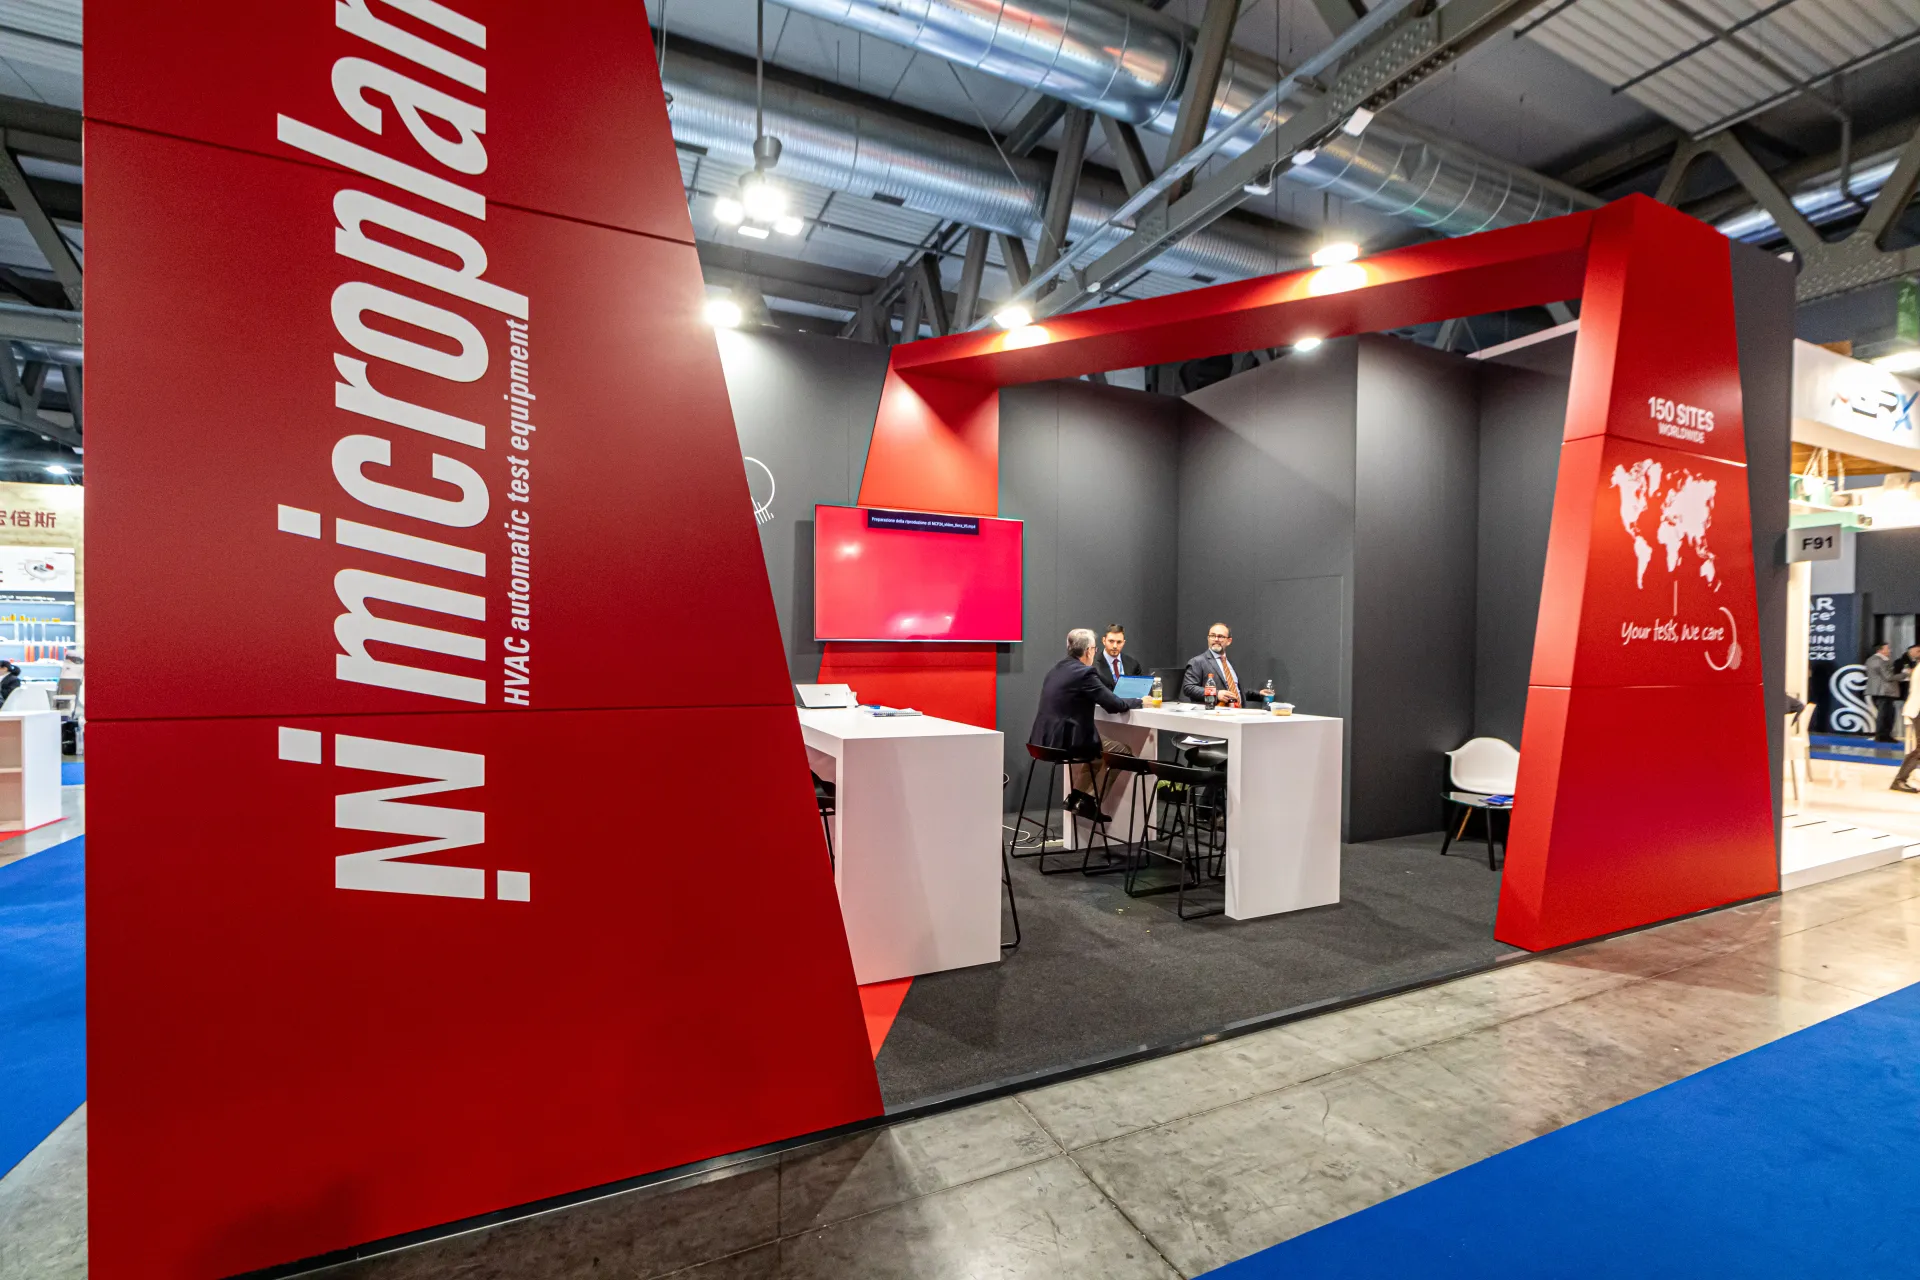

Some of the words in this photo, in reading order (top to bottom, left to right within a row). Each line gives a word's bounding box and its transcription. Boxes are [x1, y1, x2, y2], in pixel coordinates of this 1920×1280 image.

[277, 0, 530, 705] microplan
[503, 319, 537, 453] equipment
[1648, 396, 1675, 423] 150
[1676, 403, 1715, 433] SITES
[1658, 422, 1705, 444] WORLDWIDE
[506, 455, 531, 503] test
[1802, 535, 1833, 551] F91
[503, 509, 531, 632] automatic
[1621, 622, 1651, 646] Your
[1653, 618, 1679, 643] tests,
[1701, 627, 1724, 641] care
[503, 636, 531, 707] HVAC
